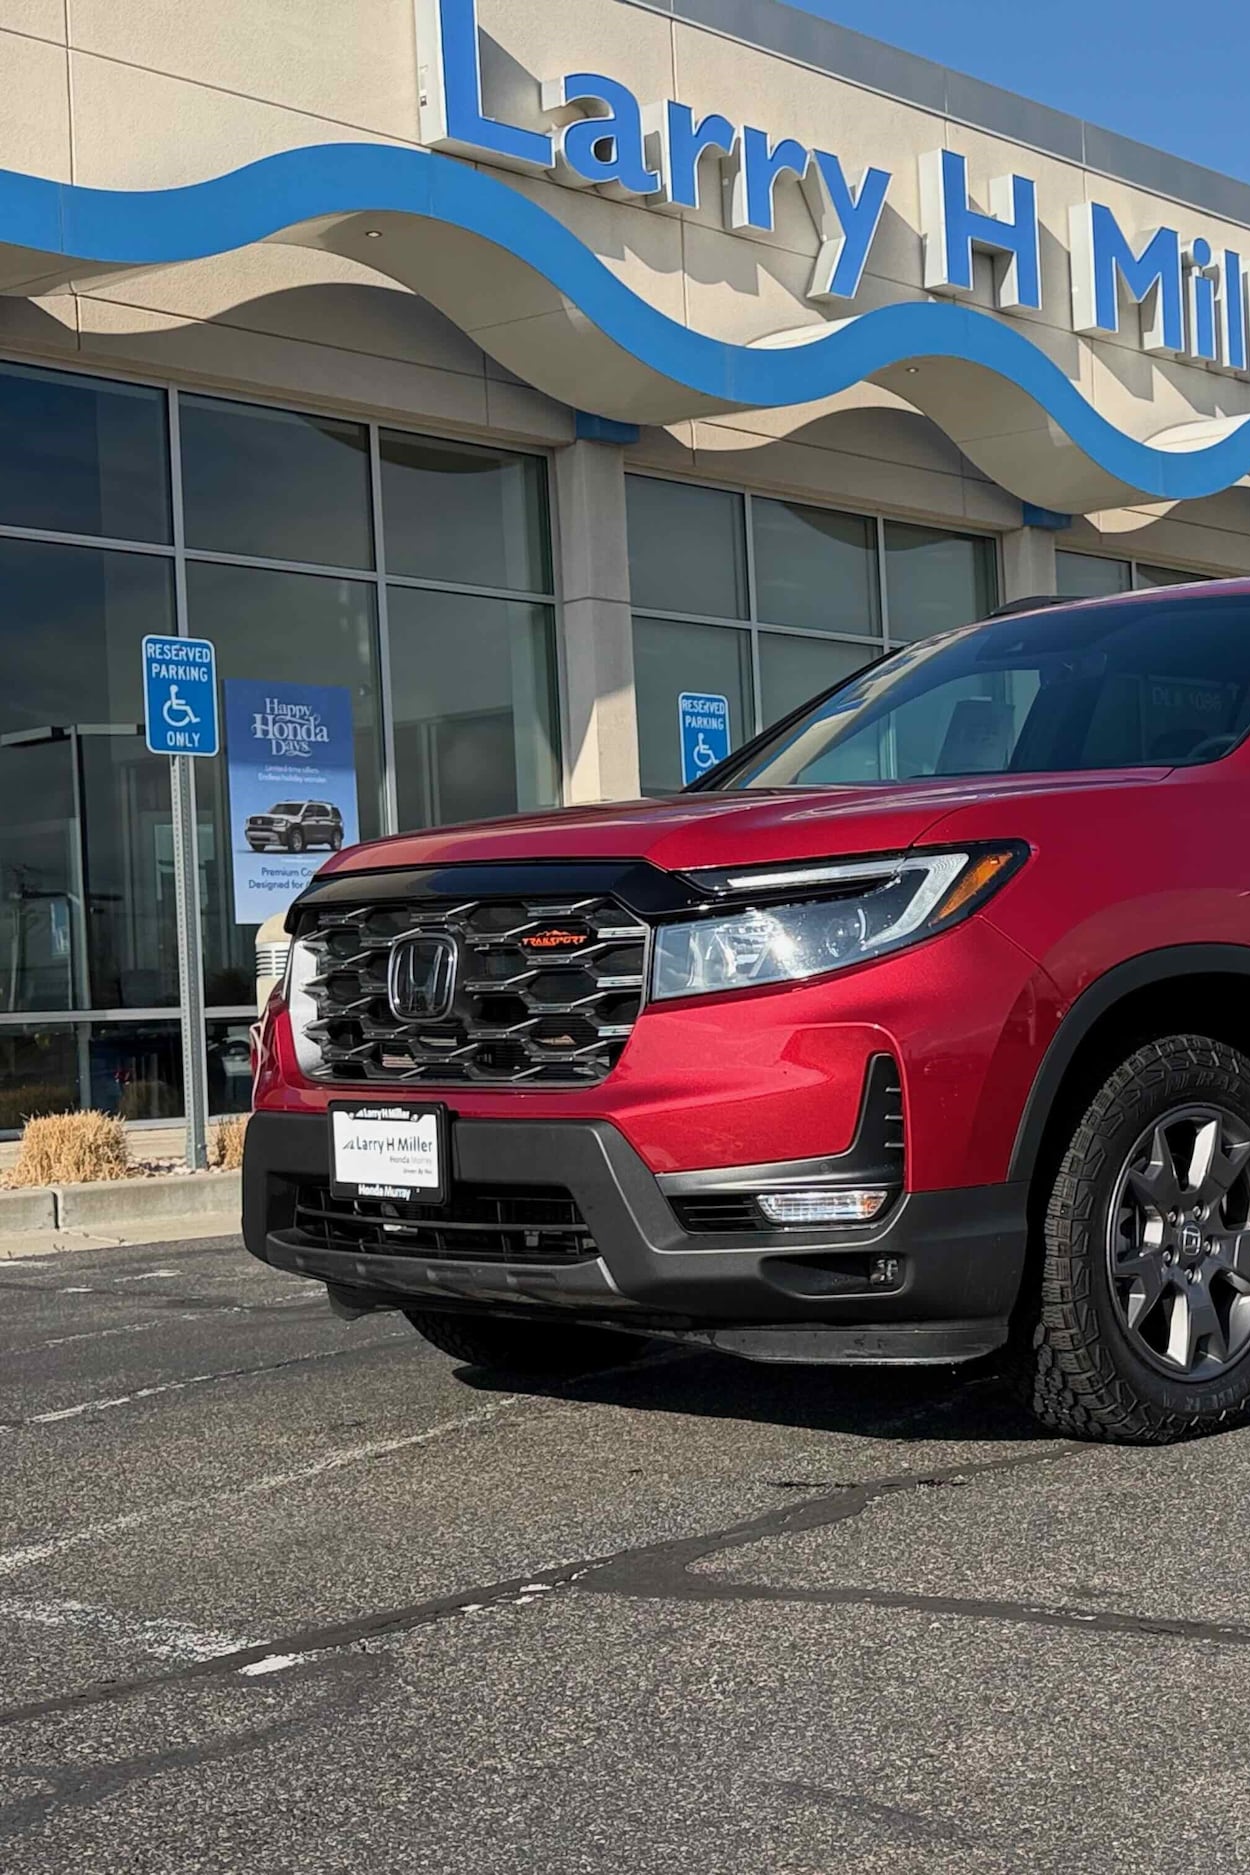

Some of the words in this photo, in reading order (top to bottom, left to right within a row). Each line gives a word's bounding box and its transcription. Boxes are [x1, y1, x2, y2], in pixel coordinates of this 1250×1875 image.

[436, 0, 893, 301] Larry
[936, 148, 1042, 311] H
[146, 643, 211, 663] RESERVED
[151, 663, 208, 682] PARKING
[264, 697, 312, 719] Happy
[682, 699, 725, 715] RESERVED
[251, 713, 330, 742] Honda
[684, 715, 725, 730] PARKING
[166, 731, 201, 748] ONLY
[271, 739, 313, 757] Days
[261, 867, 300, 877] Premium
[248, 879, 290, 891] Designed
[291, 879, 304, 889] for
[356, 1136, 384, 1155] Larry
[386, 1137, 395, 1152] H
[397, 1136, 433, 1153] Miller
[358, 1183, 383, 1197] Honda
